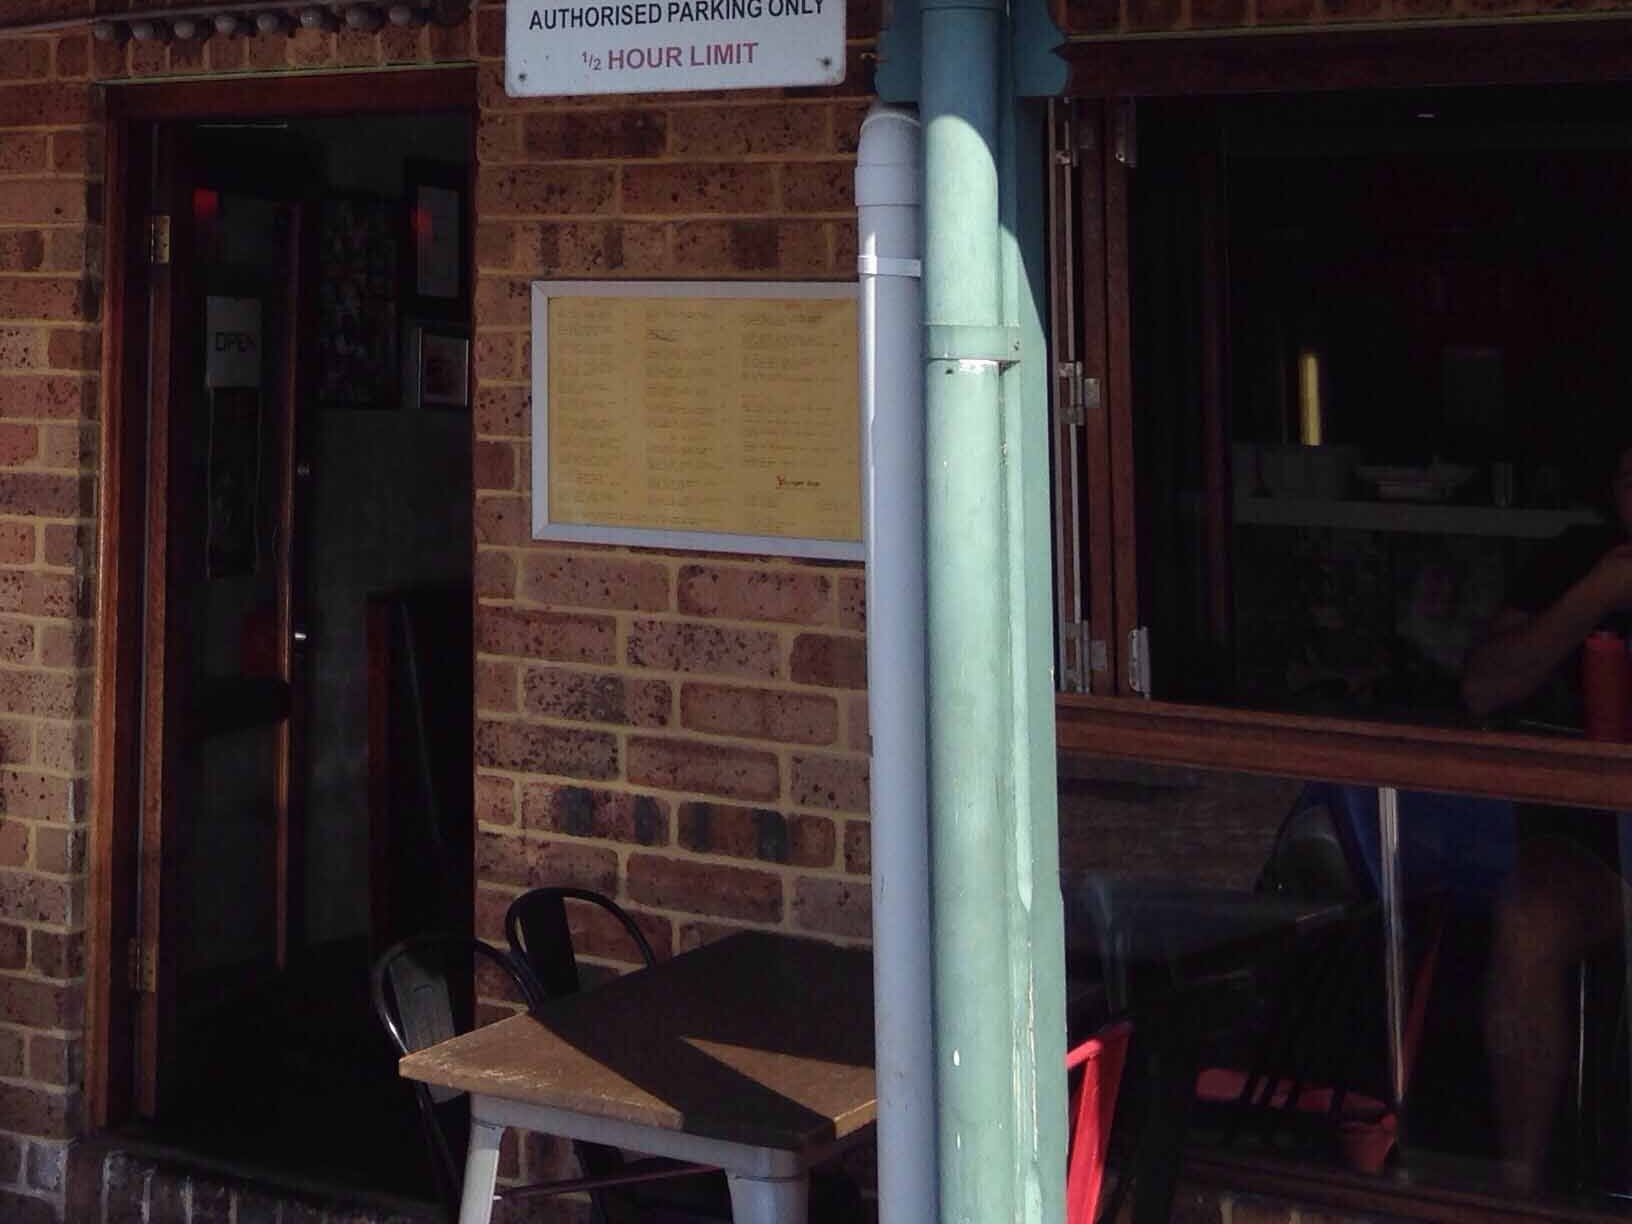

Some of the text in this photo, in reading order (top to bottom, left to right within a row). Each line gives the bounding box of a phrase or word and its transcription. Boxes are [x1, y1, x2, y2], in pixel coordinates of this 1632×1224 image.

[528, 2, 662, 31] AUTHORISED
[608, 46, 683, 70] HOUR
[690, 42, 760, 67] LIMIT
